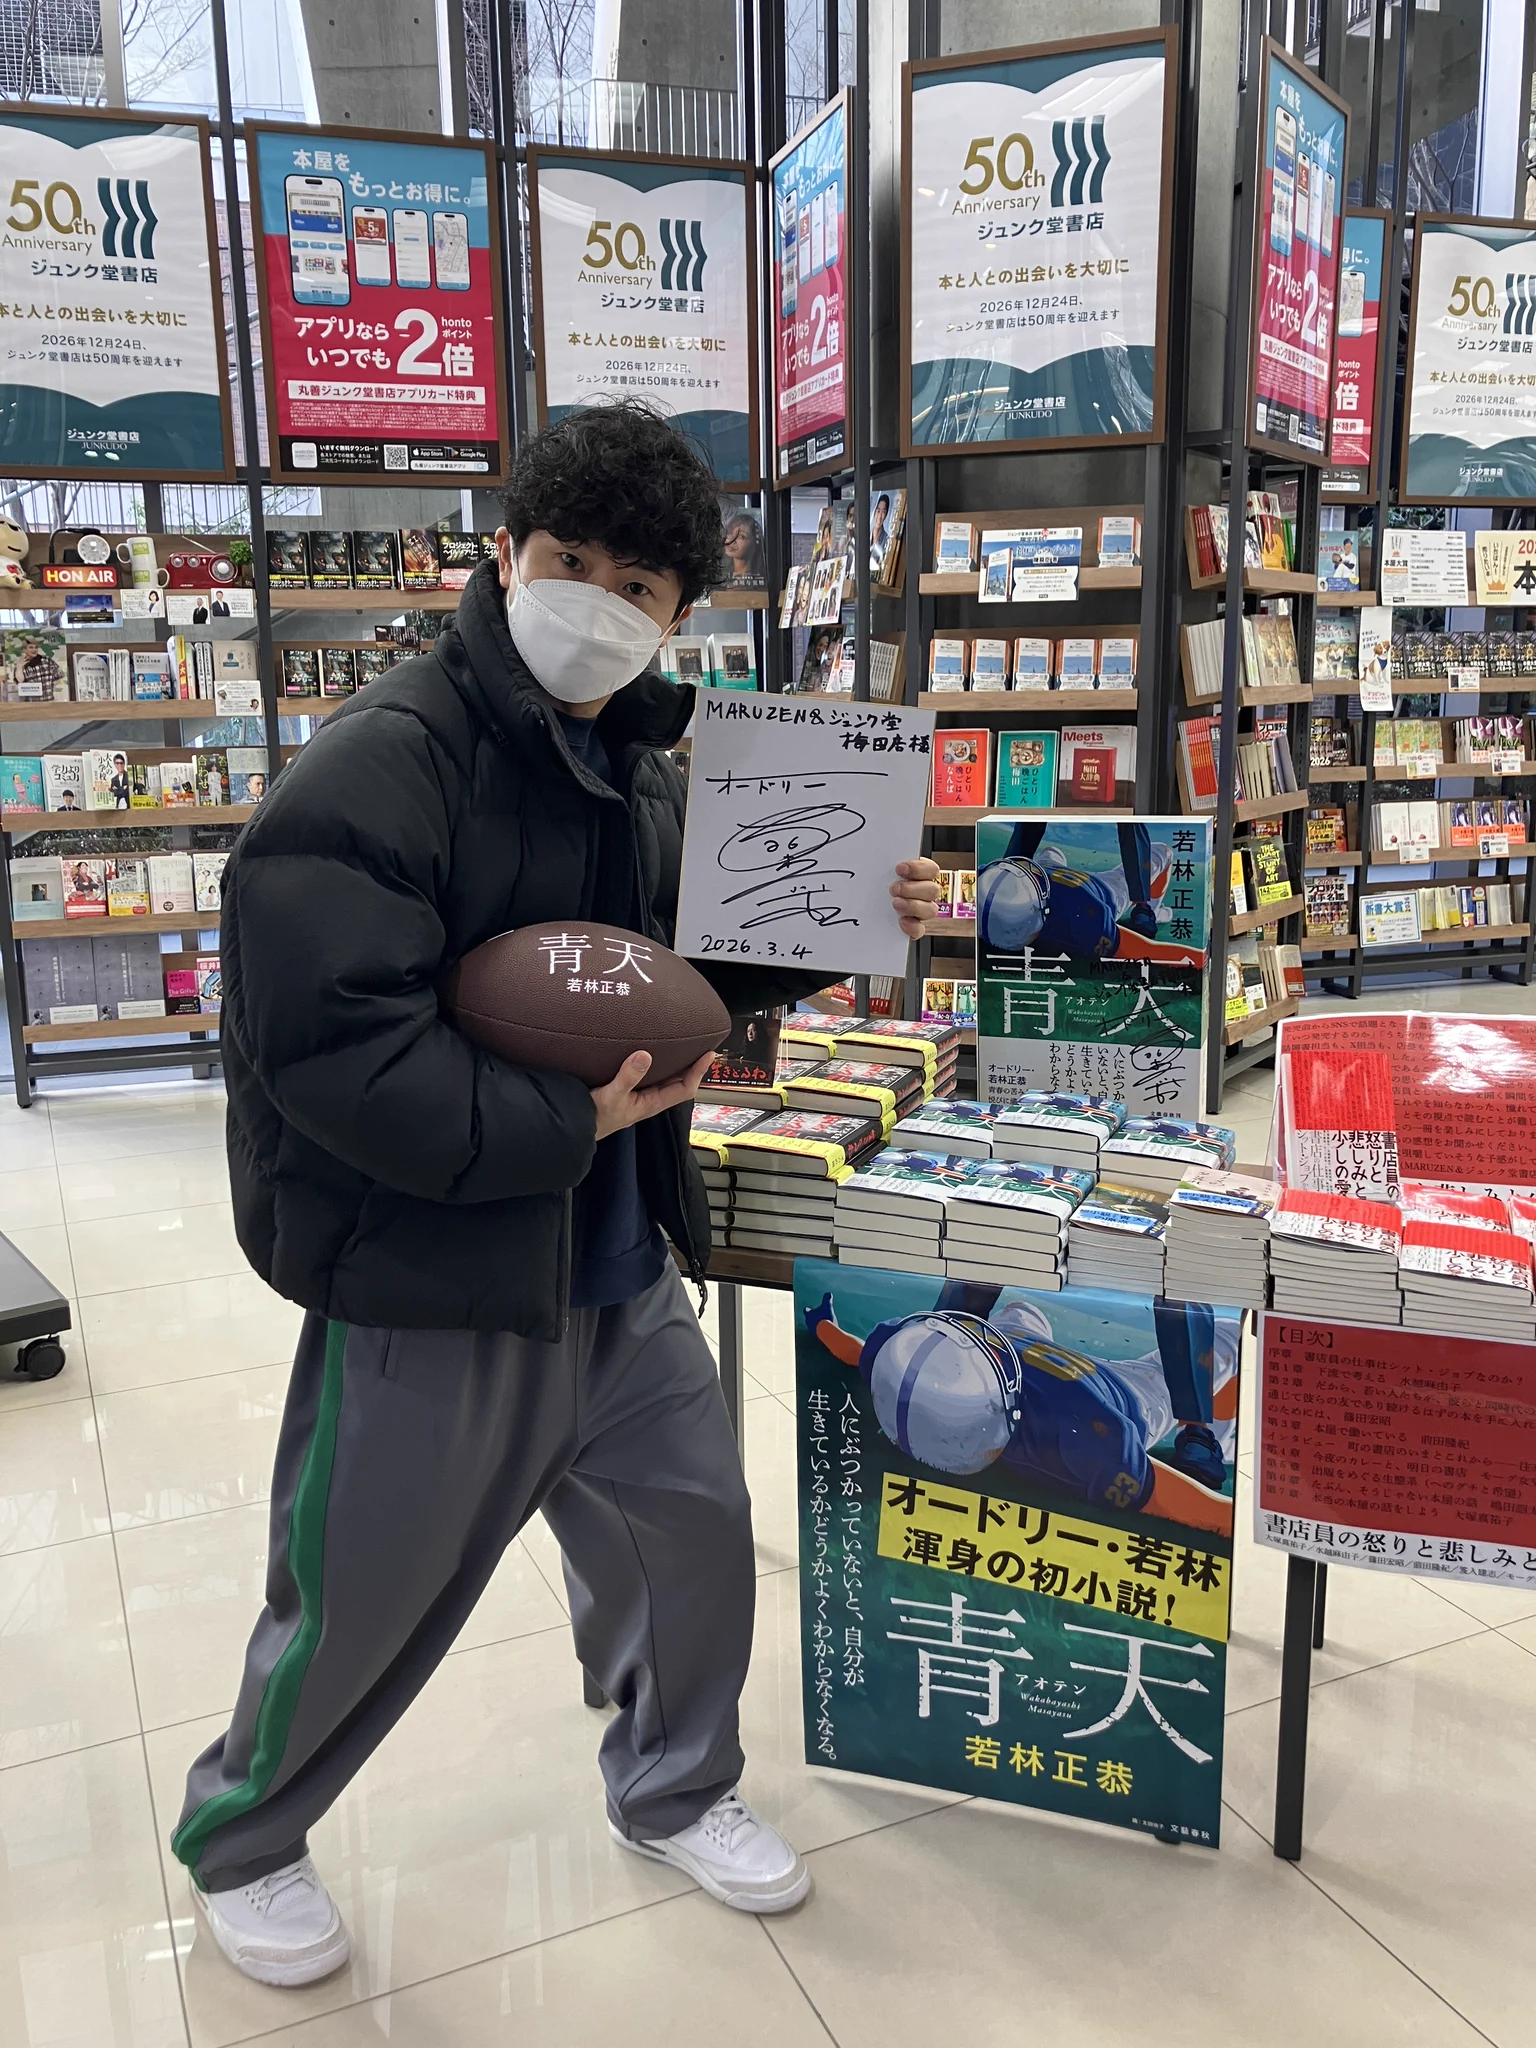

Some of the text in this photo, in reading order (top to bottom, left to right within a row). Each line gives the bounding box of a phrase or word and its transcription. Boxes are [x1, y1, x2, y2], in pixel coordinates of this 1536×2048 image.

[293, 149, 350, 176] 本屋を
[958, 132, 1046, 198] 50th
[349, 174, 470, 206] もっとお得に。
[952, 194, 1041, 216] Anniversary
[977, 211, 1104, 241] ジュンク堂書店
[2, 234, 93, 256] Anniversary
[582, 221, 657, 271] 50th
[31, 260, 158, 284] ジュンク堂書店
[578, 271, 653, 292] Anniversary
[938, 258, 1130, 291] 本と人との出会いを大切に
[600, 293, 705, 313] ジュンク堂書店
[979, 295, 1084, 314] 2026年12月24日、
[1447, 275, 1501, 318] 50th
[0, 304, 188, 328] 本と人との出会いを大切に
[441, 316, 472, 329] honto
[946, 309, 1120, 333] ジュンク堂書店は50周年を迎えます
[294, 316, 390, 341] アプリなら
[442, 331, 473, 342] ポイント
[394, 308, 442, 376] 2
[568, 332, 727, 352] 本と人との出会いを大切に
[1457, 337, 1533, 354] ジュンク堂書店
[7, 351, 183, 370] ジュンク堂書店は50周年を迎えます
[307, 346, 391, 370] いつでも
[442, 342, 475, 377] 倍
[1338, 359, 1361, 371] honto
[577, 375, 721, 389] ジュンク堂書店は50周年を迎えます
[1338, 371, 1360, 379] ポイント
[993, 395, 1066, 410] ジュンク堂書店
[1335, 382, 1359, 411] 倍
[1006, 410, 1054, 419] JUNKUDO
[67, 428, 140, 443] ジュンク堂書店
[81, 441, 128, 451] JUNKUDO
[46, 569, 114, 584] HON AIR
[839, 732, 931, 754] 梅田店様
[1063, 731, 1104, 743] Meets
[51, 764, 80, 774] 学力より
[1082, 765, 1099, 774] 梅田
[1310, 756, 1331, 768] 2026
[946, 767, 954, 795] なんば
[955, 767, 963, 803] 晩ごはん
[1011, 767, 1020, 786] 梅田
[1020, 767, 1030, 805] 晩ごはん
[1031, 767, 1039, 796] ひとり
[1079, 773, 1101, 783] 大辞典
[1260, 844, 1274, 853] THE
[1258, 857, 1281, 869] STORY
[1170, 829, 1197, 940] 若林正恭
[1265, 873, 1278, 884] ART
[1307, 884, 1345, 893] プロ野球
[1365, 901, 1404, 916] 新書大賞
[537, 932, 653, 984] 青天
[700, 934, 813, 960] 2026.3.4
[566, 977, 631, 997] 若林正恭
[983, 945, 1196, 1041] 青天
[1064, 995, 1110, 1007] アオテン
[988, 1074, 1027, 1086] 若林正恭
[1365, 1131, 1382, 1184] 怒りと
[1382, 1131, 1400, 1200] 書店員の
[1278, 1325, 1335, 1350] 【目次】
[838, 1393, 865, 1688] 人にぶつかっていないと、自分が
[886, 1479, 1223, 1593] オードリー・若林
[807, 1388, 838, 1762] 生きているかどうかよくわからなくなる。
[886, 1591, 1215, 1765] 青天
[1013, 1673, 1089, 1697] アオテン
[1019, 1691, 1081, 1711] Wakabayashi
[1027, 1703, 1072, 1719] Masayasu
[964, 1734, 1133, 1796] 若林正恭
[1169, 1823, 1211, 1841] 文藝春秋
